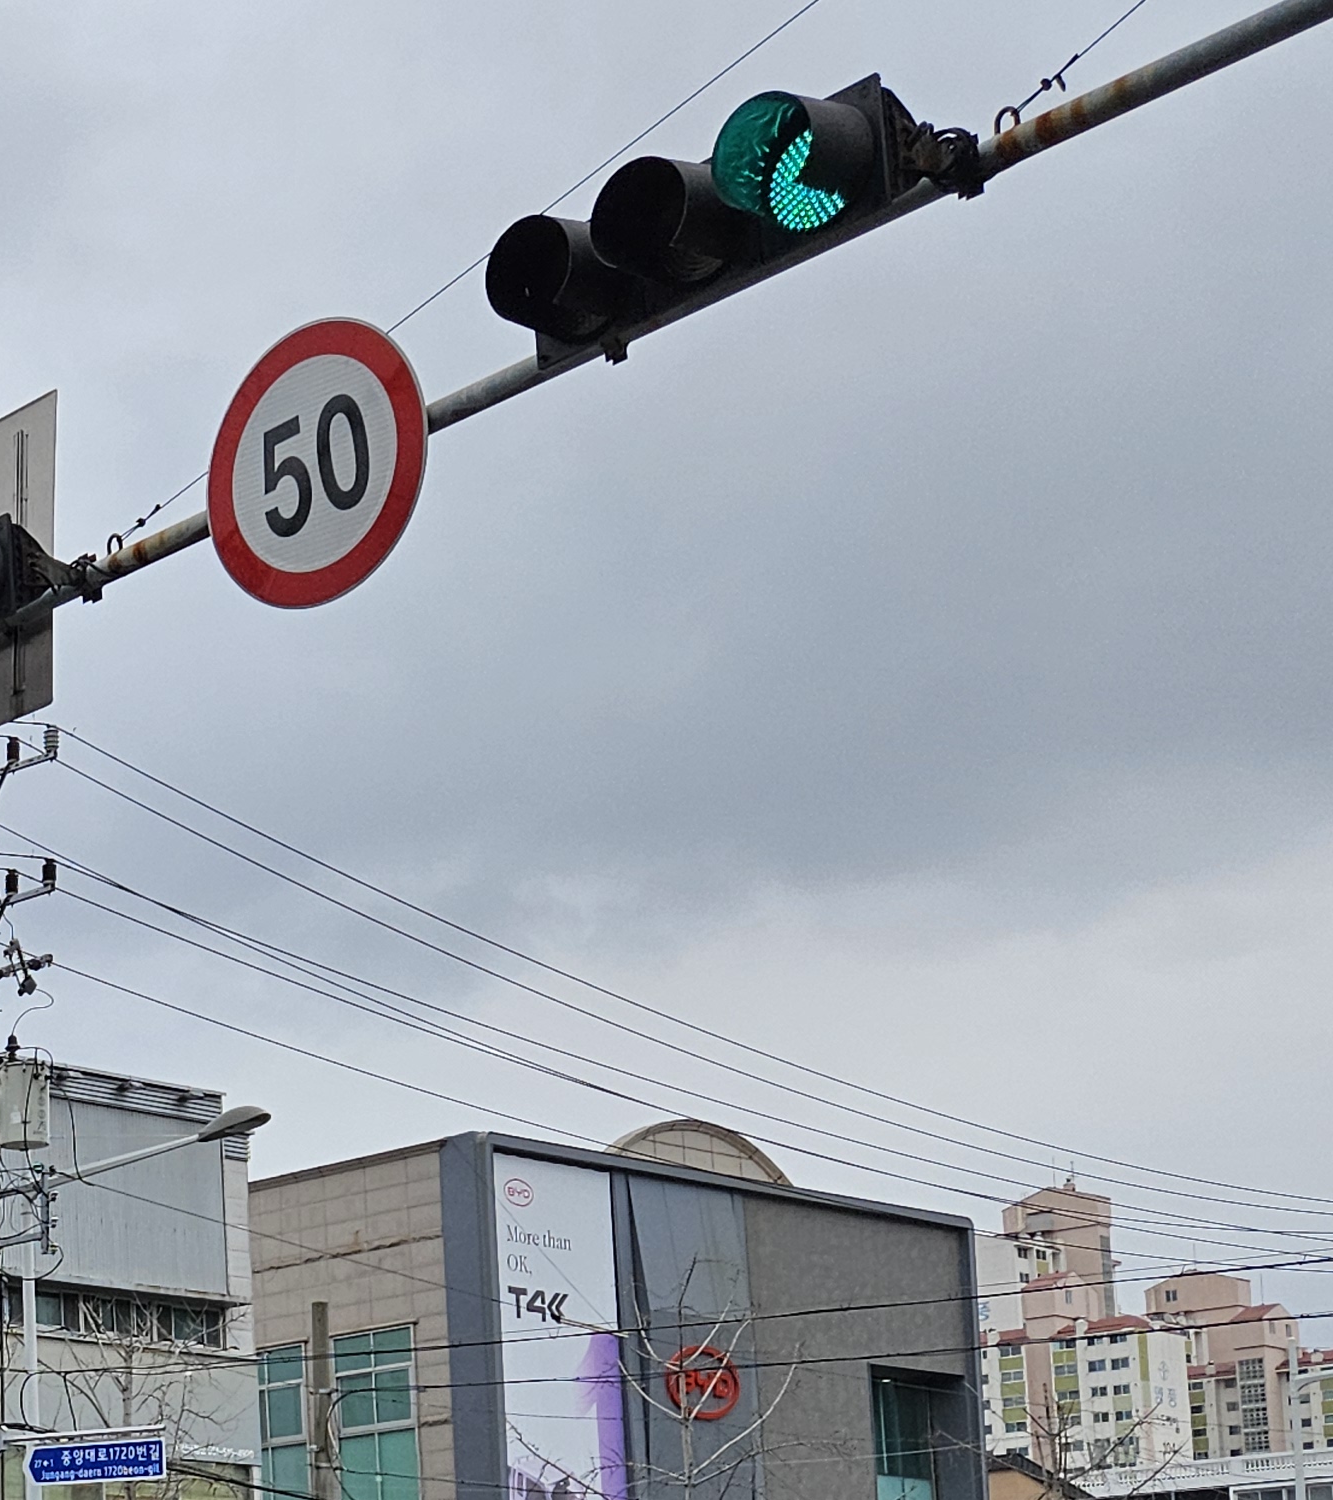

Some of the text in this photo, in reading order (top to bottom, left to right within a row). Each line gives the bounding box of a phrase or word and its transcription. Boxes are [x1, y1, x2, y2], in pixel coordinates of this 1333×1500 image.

[263, 393, 370, 538] 50
[507, 1186, 531, 1199] BYD
[507, 1224, 572, 1251] More than
